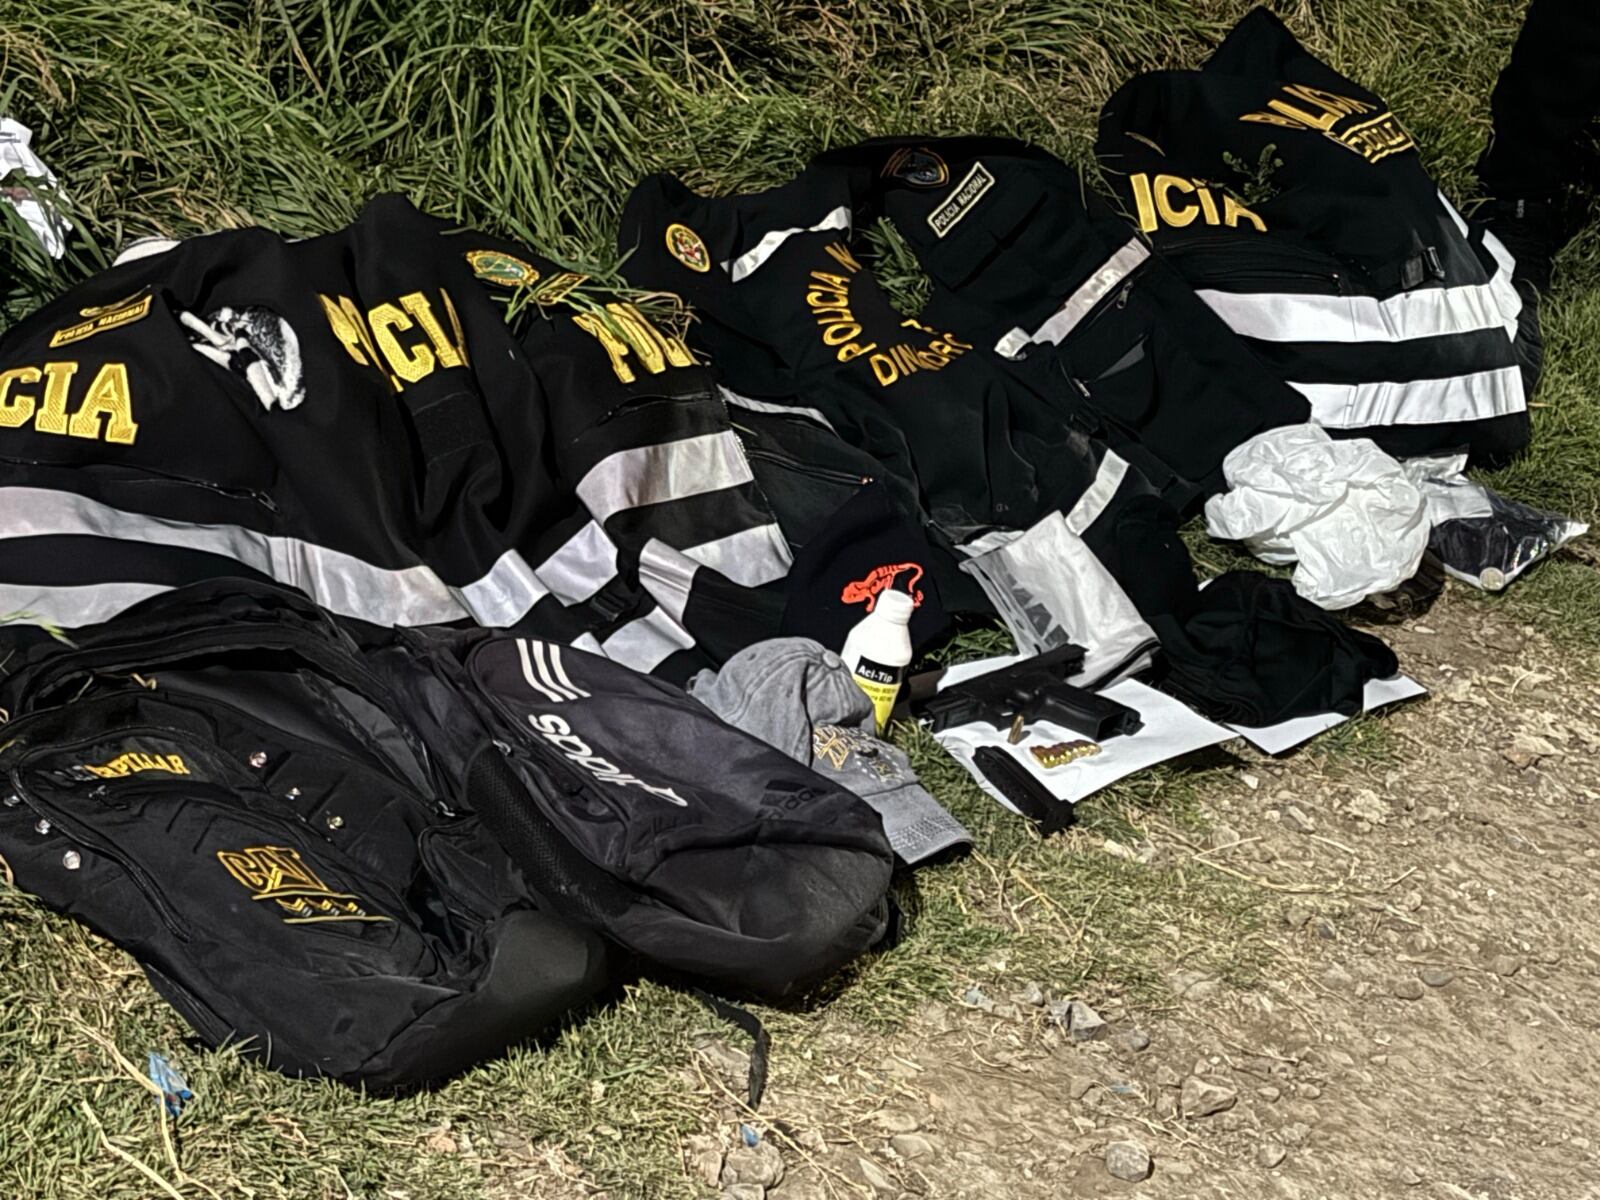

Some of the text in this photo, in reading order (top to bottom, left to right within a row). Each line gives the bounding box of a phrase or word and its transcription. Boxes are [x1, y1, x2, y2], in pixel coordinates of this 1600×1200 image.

[934, 173, 986, 229] POLICIA NACIONAL
[806, 271, 877, 363] POLICIA
[0, 361, 138, 444] CIA
[216, 845, 329, 893] CAT
